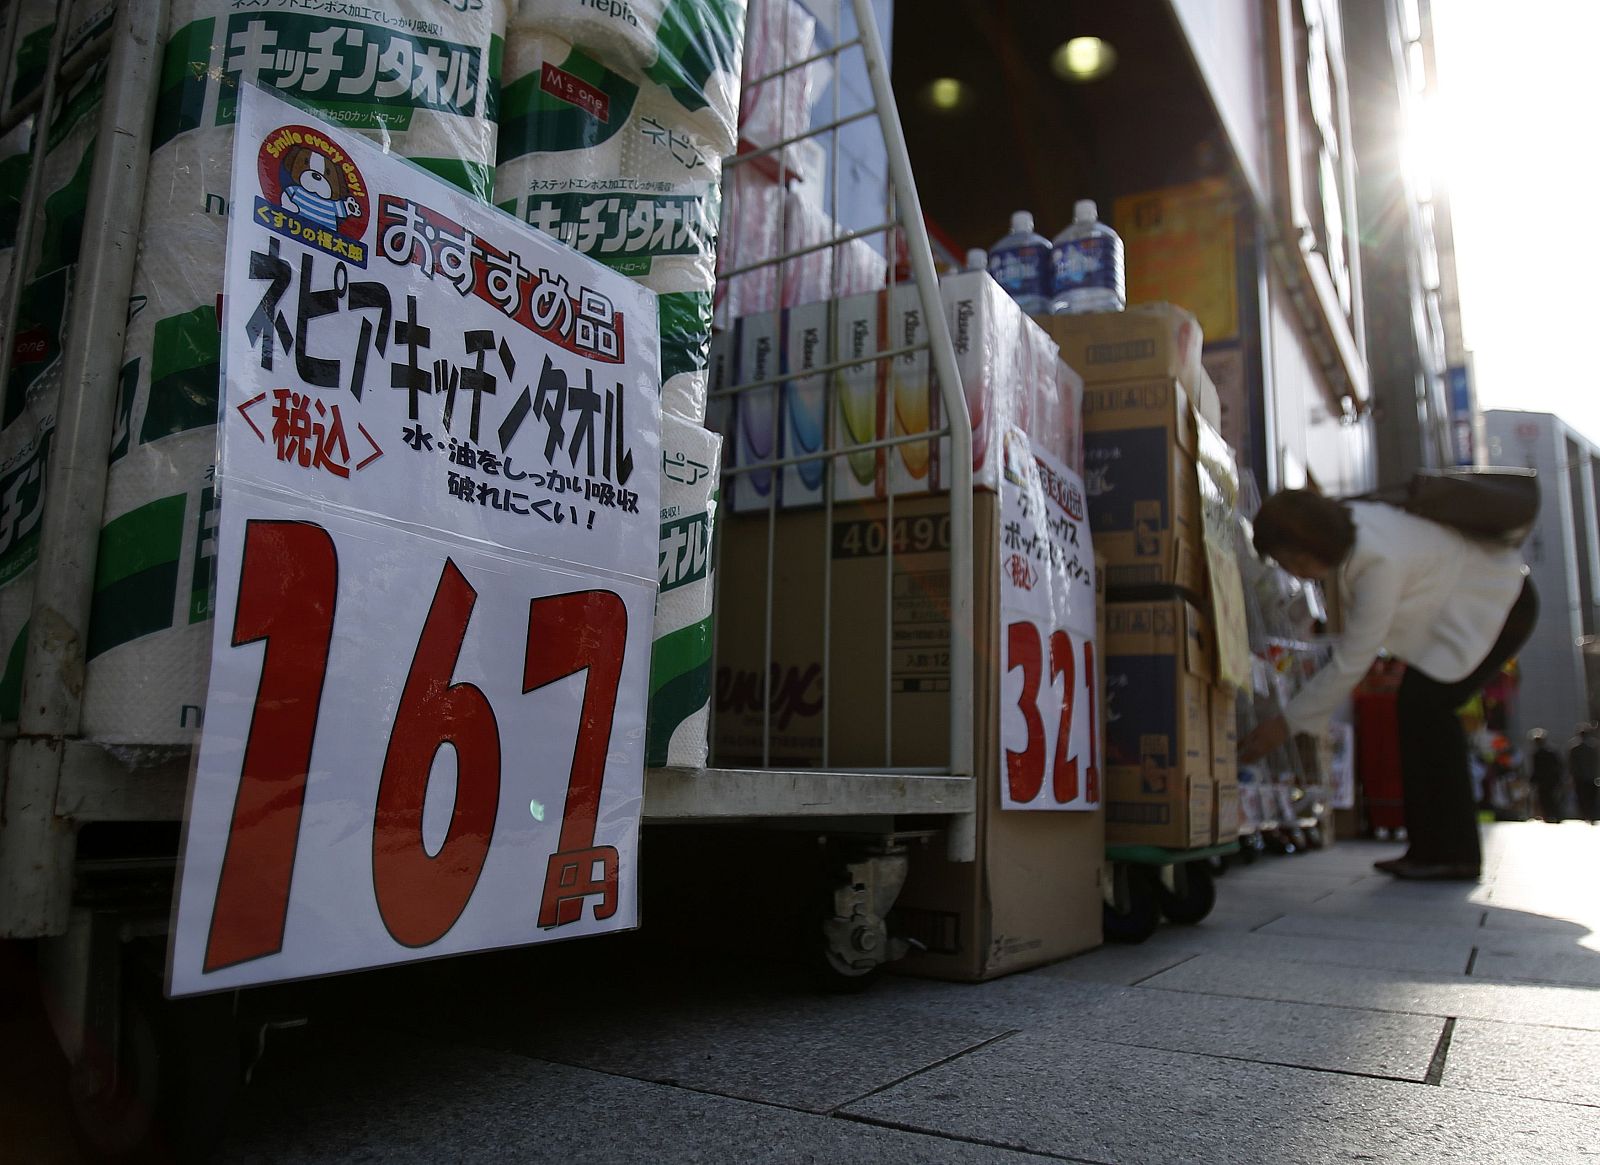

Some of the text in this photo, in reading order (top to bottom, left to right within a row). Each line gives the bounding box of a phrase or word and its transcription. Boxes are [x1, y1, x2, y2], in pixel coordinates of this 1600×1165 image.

[227, 20, 477, 108] キッチンタオル
[546, 69, 575, 93] M's
[578, 88, 603, 109] one
[266, 130, 366, 198] Smile every day!
[257, 206, 364, 262] くすりの福太郎
[383, 200, 620, 360] おすすめ品
[245, 236, 634, 487] ネピアキッチンタオル
[402, 424, 640, 514] 水・油をしっかり吸収
[447, 470, 595, 530] 破れにくい！
